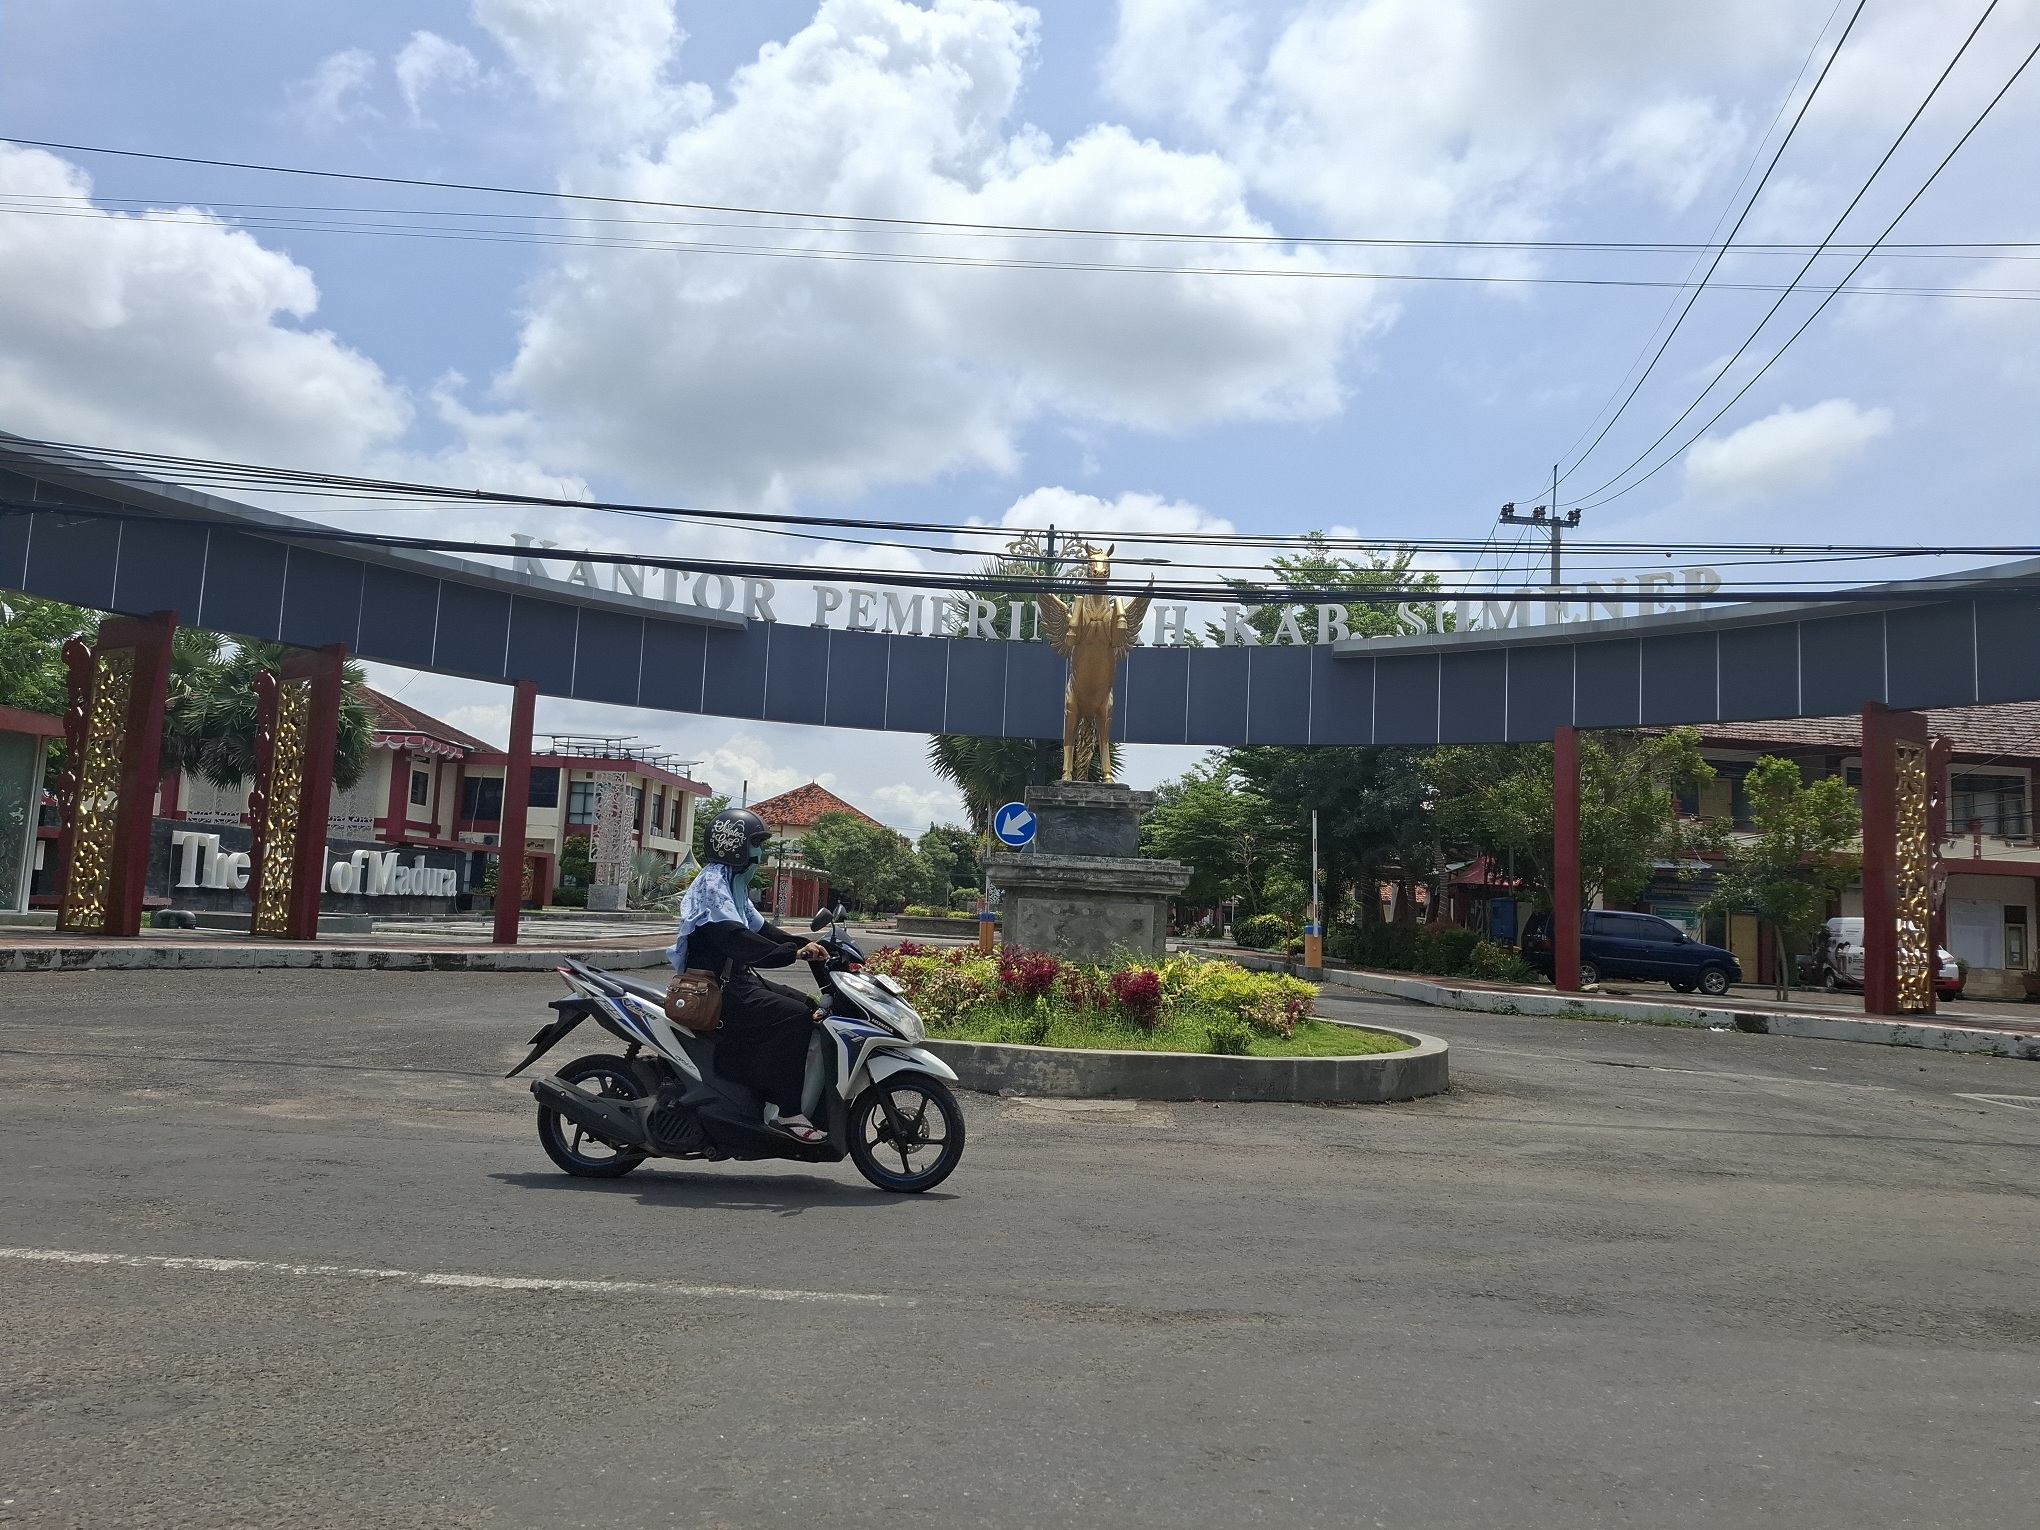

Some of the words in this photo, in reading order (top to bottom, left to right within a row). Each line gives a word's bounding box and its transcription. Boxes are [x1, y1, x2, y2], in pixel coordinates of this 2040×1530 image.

[510, 532, 778, 623] KANTOR
[171, 829, 251, 890] The
[330, 849, 370, 895] of
[367, 850, 458, 897] Madura
[871, 1017, 894, 1033] HONDA
